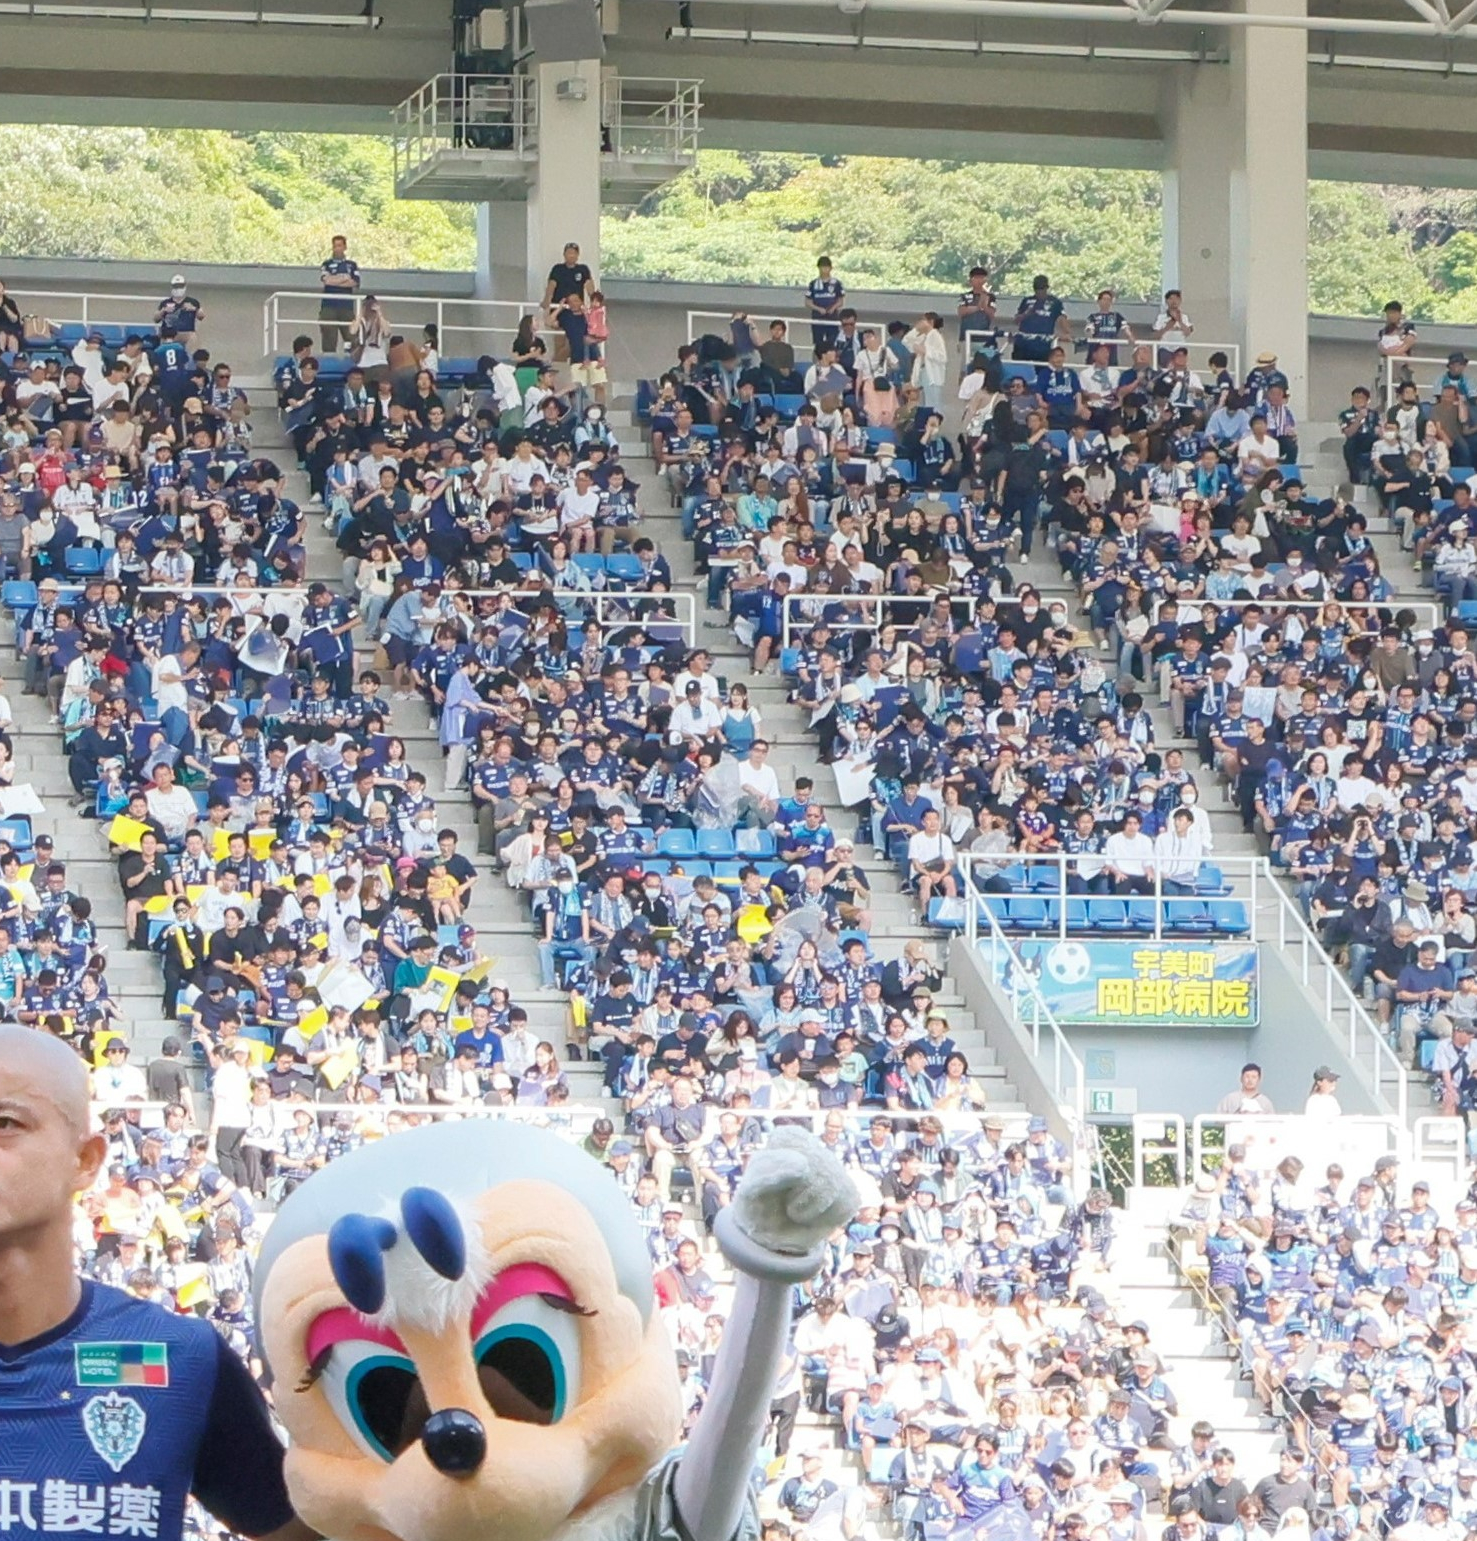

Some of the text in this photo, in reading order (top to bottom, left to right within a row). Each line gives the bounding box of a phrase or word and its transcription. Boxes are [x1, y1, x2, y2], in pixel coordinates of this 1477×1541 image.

[1132, 949, 1216, 978] 宇美町
[1096, 977, 1250, 1019] 岡部病院
